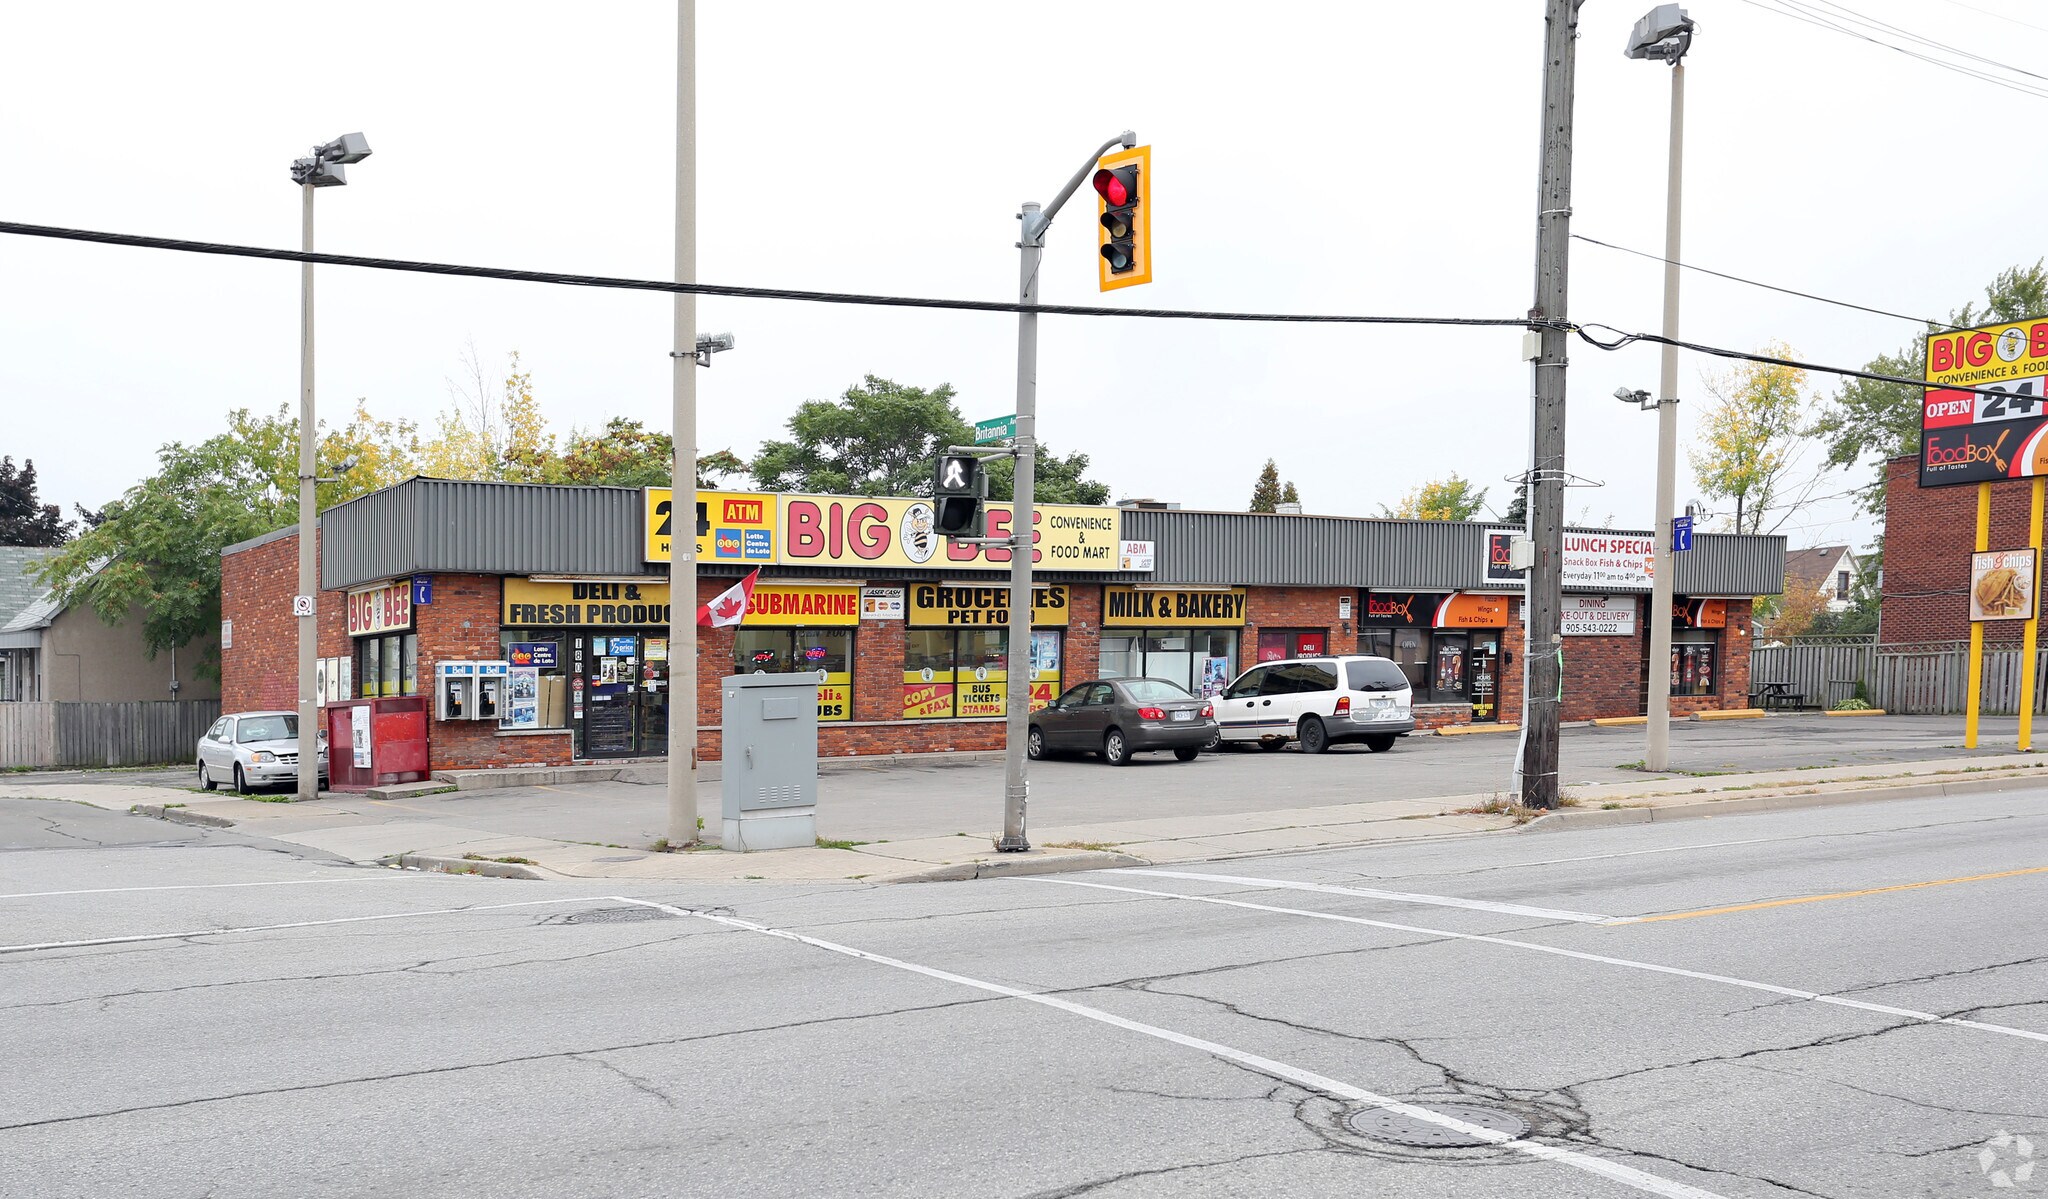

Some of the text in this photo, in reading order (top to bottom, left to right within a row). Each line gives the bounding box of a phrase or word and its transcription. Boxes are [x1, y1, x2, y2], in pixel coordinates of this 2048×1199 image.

[1932, 331, 1993, 373] BIG
[1936, 367, 2006, 385] CONVENIENCE
[2010, 365, 2018, 376] &
[1926, 382, 2034, 418] OPEN 24
[975, 421, 1007, 441] Britannia
[726, 503, 759, 520] ATM
[787, 500, 891, 560] BIG
[1050, 515, 1112, 530] CONVENIENCE
[717, 539, 740, 549] OLG
[1078, 531, 1086, 544] &
[1051, 545, 1110, 560] FOOD MART
[1126, 543, 1147, 554] ABM
[1492, 535, 1511, 562] Foo
[1564, 537, 1655, 555] LUNCH SPECIA
[1564, 557, 1584, 566] Snack
[1585, 558, 1598, 567] Box
[1599, 558, 1614, 568] Fish
[1615, 559, 1621, 568] &
[1623, 559, 1643, 570] Chips
[1974, 551, 2032, 570] fish & chips
[1563, 571, 1592, 581] Everyday
[1617, 573, 1624, 581] to
[572, 583, 641, 600] DELI &
[917, 585, 1065, 608] GROCEES
[350, 584, 409, 632] BIG BEE
[746, 593, 857, 616] SUBMARINE
[1109, 591, 1245, 619] MILK & BAKERY
[1579, 599, 1606, 608] DINING
[510, 604, 581, 623] FRESH
[947, 609, 1035, 624] PET FO
[1474, 616, 1488, 624] Chips
[1561, 610, 1631, 620] KE-OUT & DELIVERY
[1565, 623, 1618, 632] 905-543-0222
[620, 644, 634, 652] price
[1402, 640, 1416, 648] OPEN
[452, 666, 466, 674] Bell
[486, 666, 500, 674] Bell
[817, 689, 843, 701] eli &
[904, 685, 936, 706] COPY
[972, 684, 991, 693] BUS
[1029, 683, 1053, 702] 4
[963, 693, 1001, 703] TICKETS
[817, 704, 843, 717] BS
[919, 697, 951, 716] & FAX
[962, 705, 1001, 714] STAMPS
